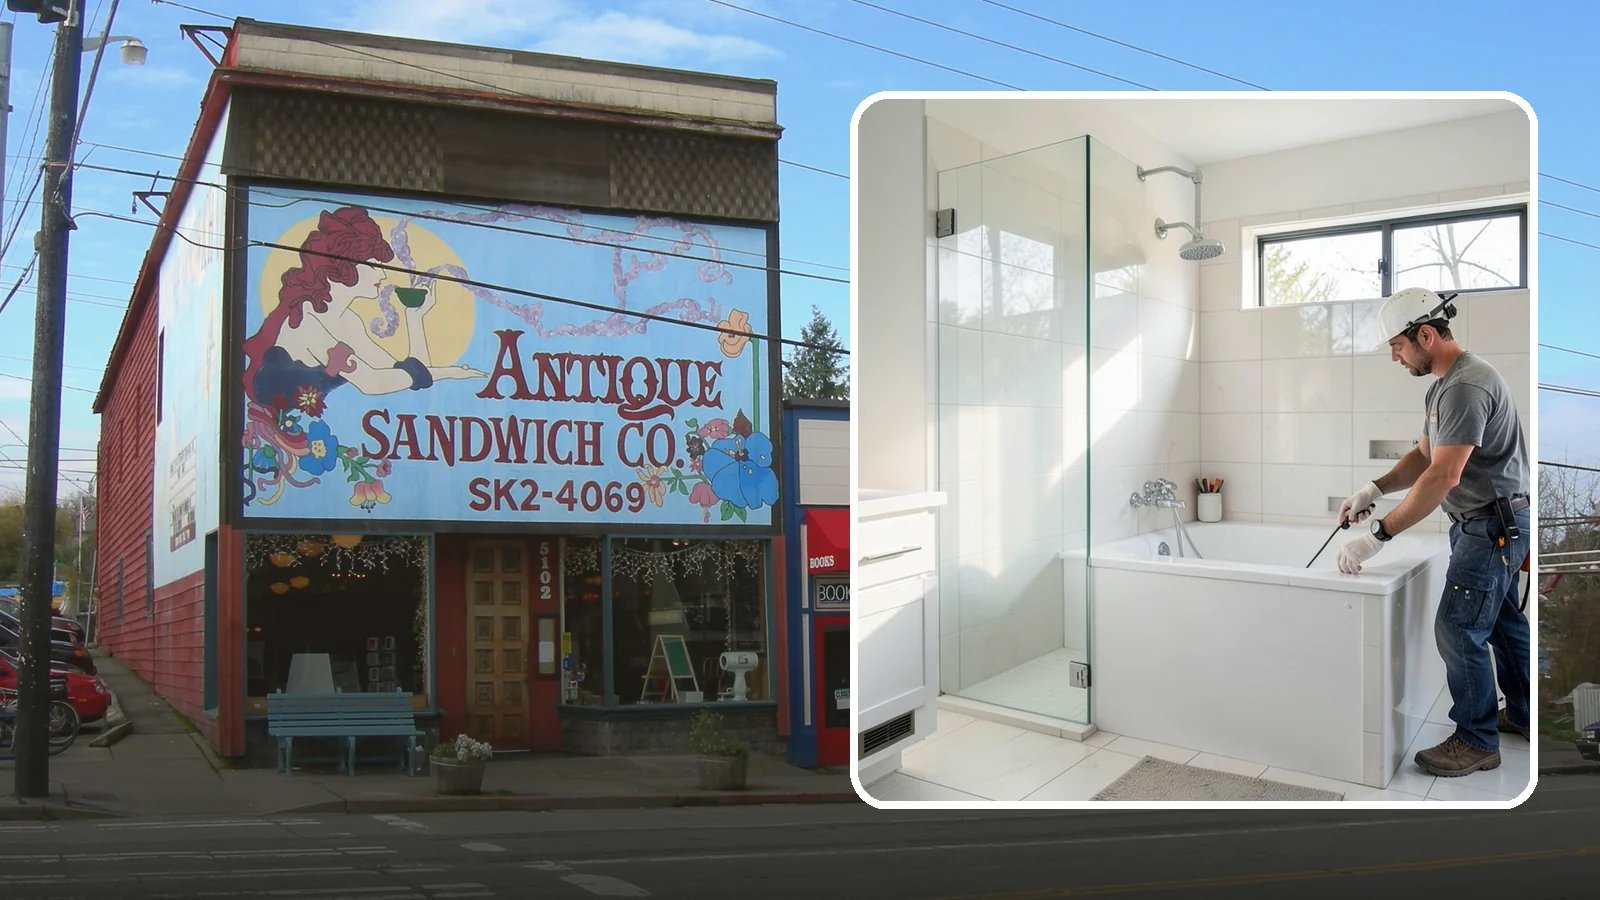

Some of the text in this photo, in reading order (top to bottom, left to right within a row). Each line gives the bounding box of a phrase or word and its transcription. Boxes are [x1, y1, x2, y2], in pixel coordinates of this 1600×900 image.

[476, 329, 723, 421] ANTIQUE
[361, 408, 685, 469] SANDWICH CO.
[468, 477, 646, 513] SK2-4069
[540, 541, 552, 600] 5102
[809, 555, 835, 569] BOOKS
